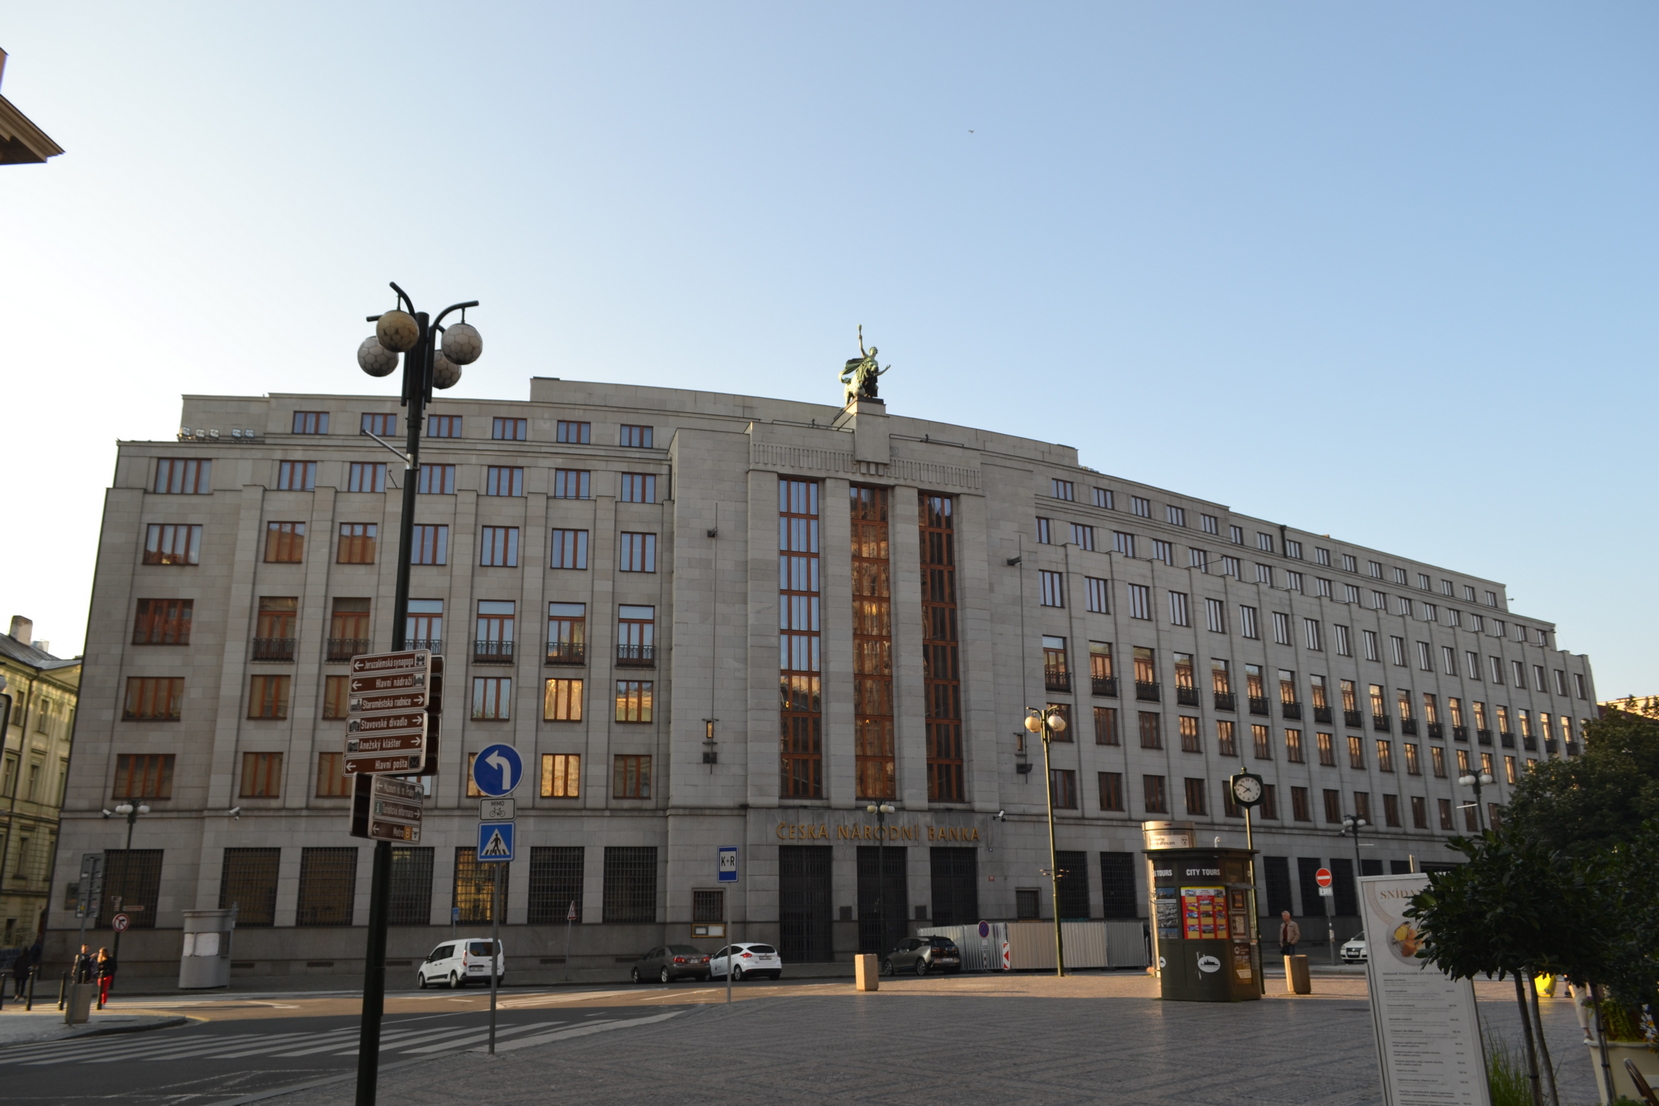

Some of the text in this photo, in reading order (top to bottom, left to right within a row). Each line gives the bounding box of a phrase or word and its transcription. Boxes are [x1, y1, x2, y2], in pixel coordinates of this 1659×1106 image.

[394, 658, 414, 669] synagoga
[375, 676, 413, 688] Hlavní nádraží
[362, 696, 411, 709] Staroměstská radnice
[361, 717, 408, 730] Stavovské divadlo
[360, 738, 402, 751] Anežský klášter
[375, 758, 408, 771] Hlavní pošta
[393, 826, 404, 838] Metro
[776, 822, 980, 842] ČESKÁ NÁRODNÍ BANKA
[721, 856, 735, 867] K+R
[1186, 868, 1221, 877] CITY TOURS
